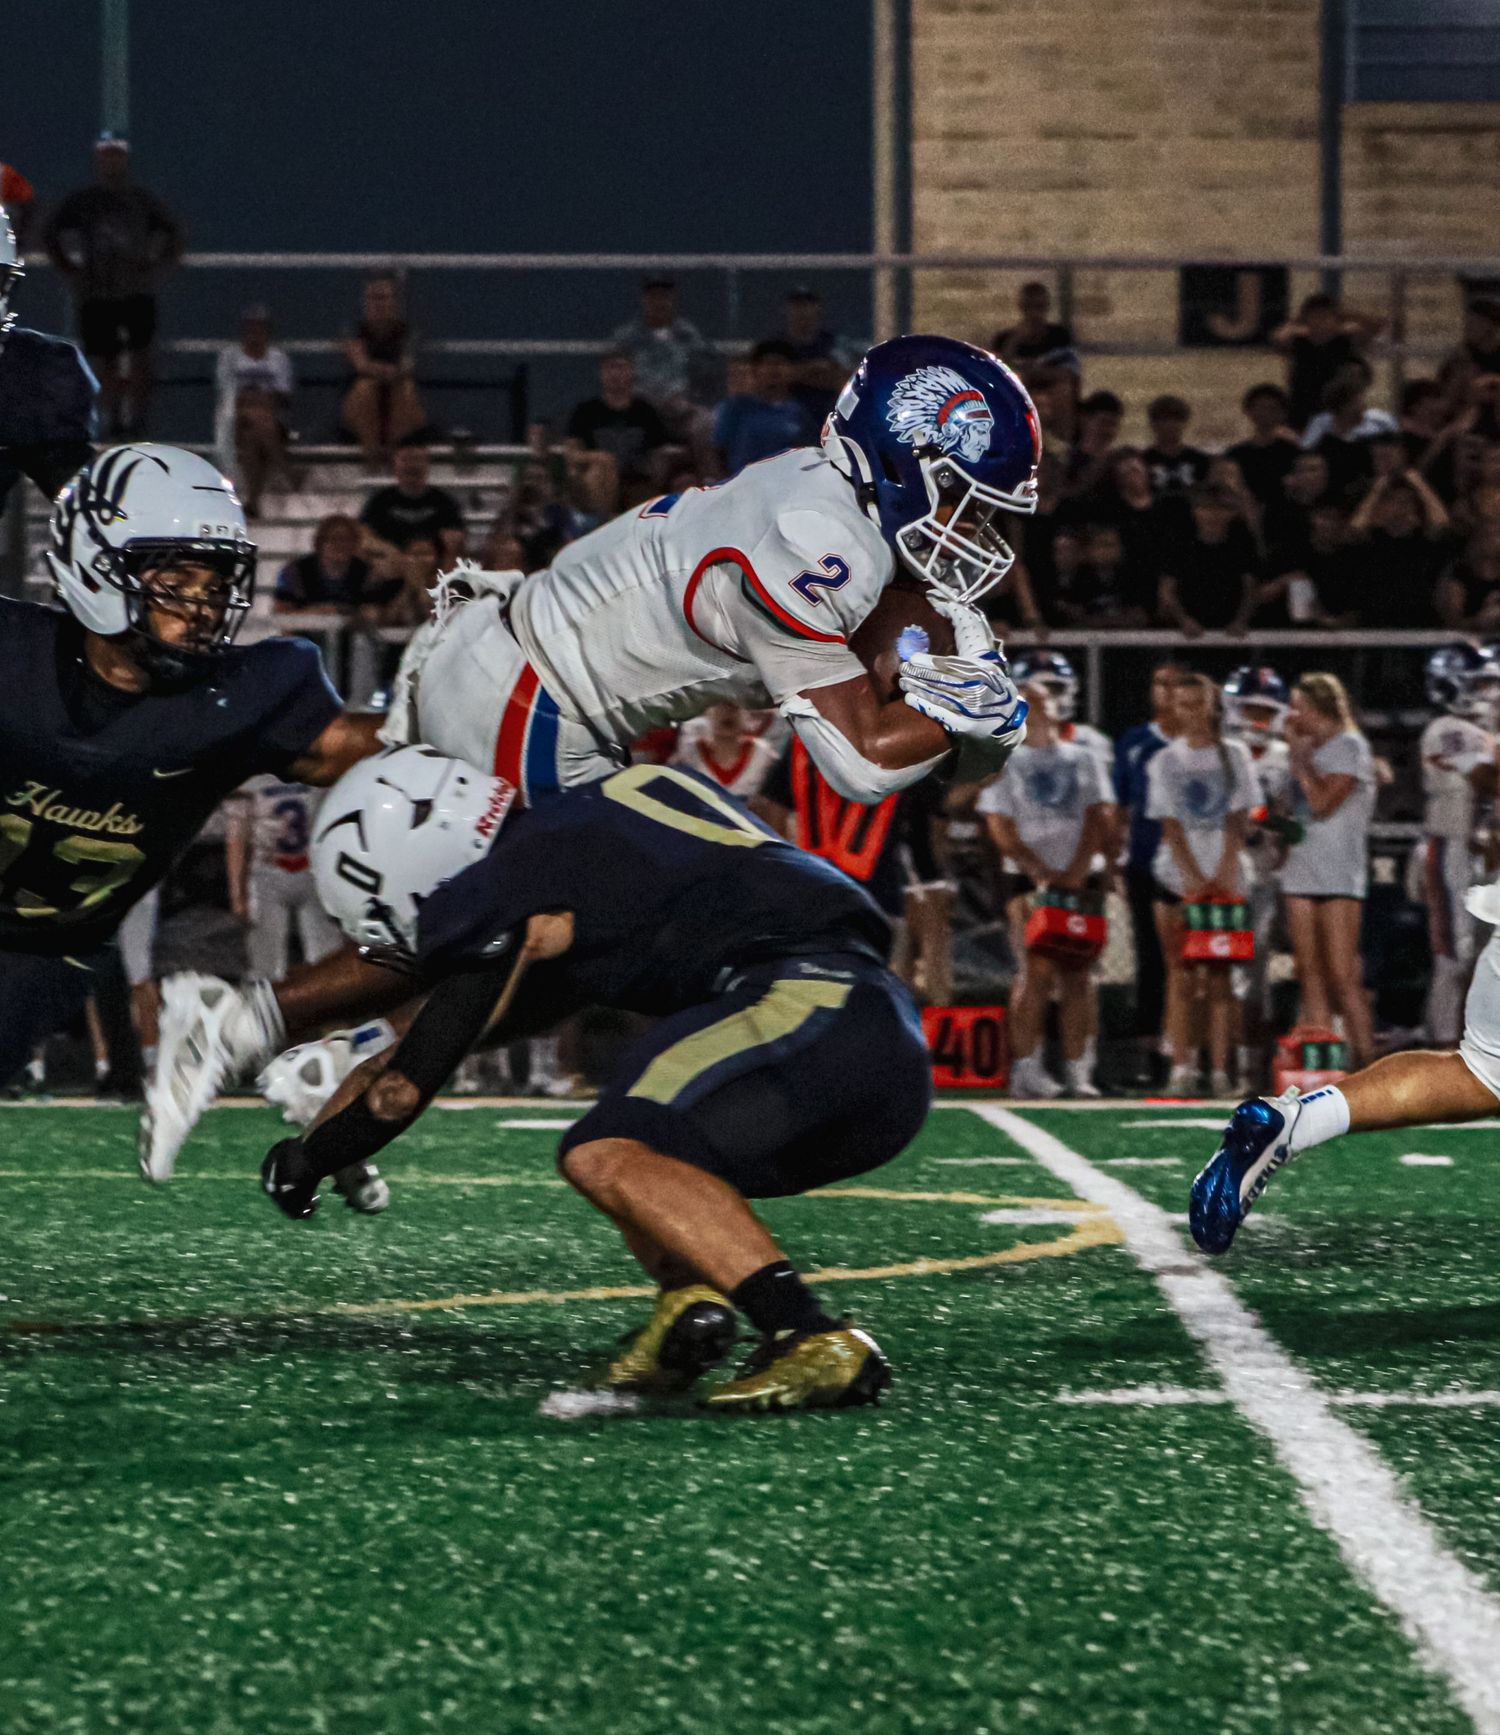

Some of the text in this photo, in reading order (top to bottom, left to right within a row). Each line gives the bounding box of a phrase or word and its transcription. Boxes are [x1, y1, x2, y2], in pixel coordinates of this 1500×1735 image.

[1205, 271, 1262, 339] J
[788, 552, 852, 608] 2
[5, 780, 145, 835] Hawks
[335, 851, 384, 896] 0
[933, 1016, 1002, 1078] 40
